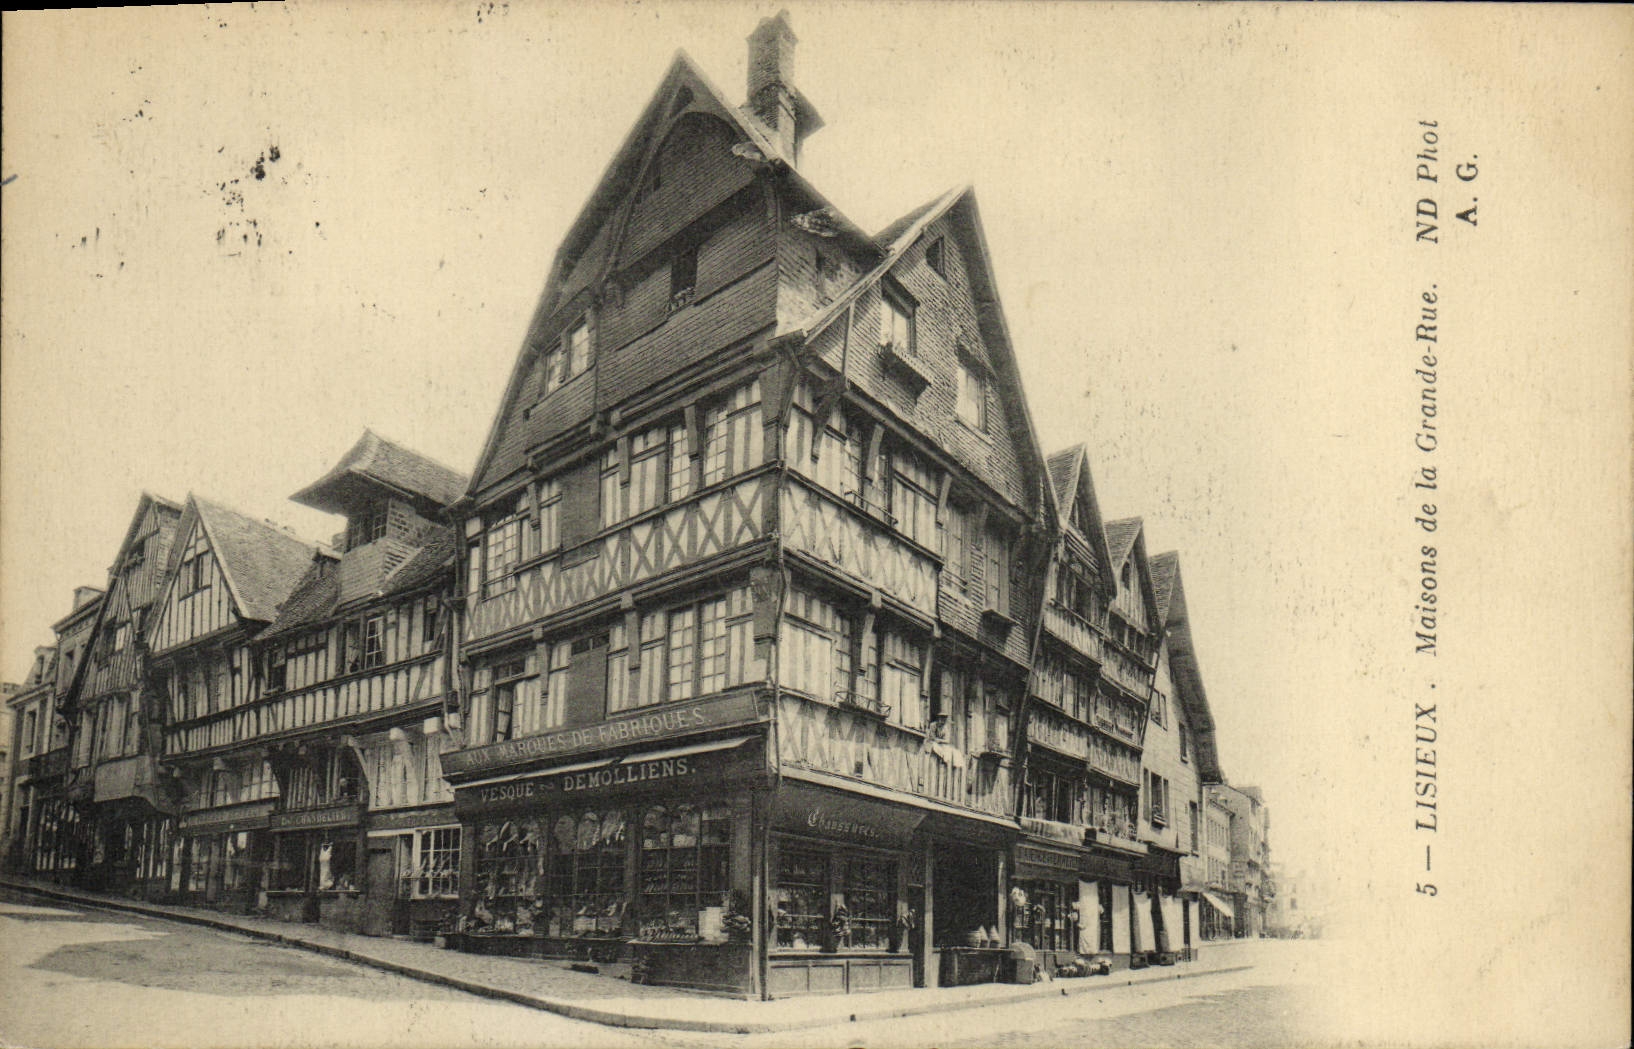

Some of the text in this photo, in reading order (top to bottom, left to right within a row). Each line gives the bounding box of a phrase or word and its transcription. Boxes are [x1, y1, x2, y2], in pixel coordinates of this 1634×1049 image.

[498, 734, 565, 760] MARQUES
[572, 729, 593, 748] DE
[480, 758, 697, 804] VESQUE DEMOLLIENS.
